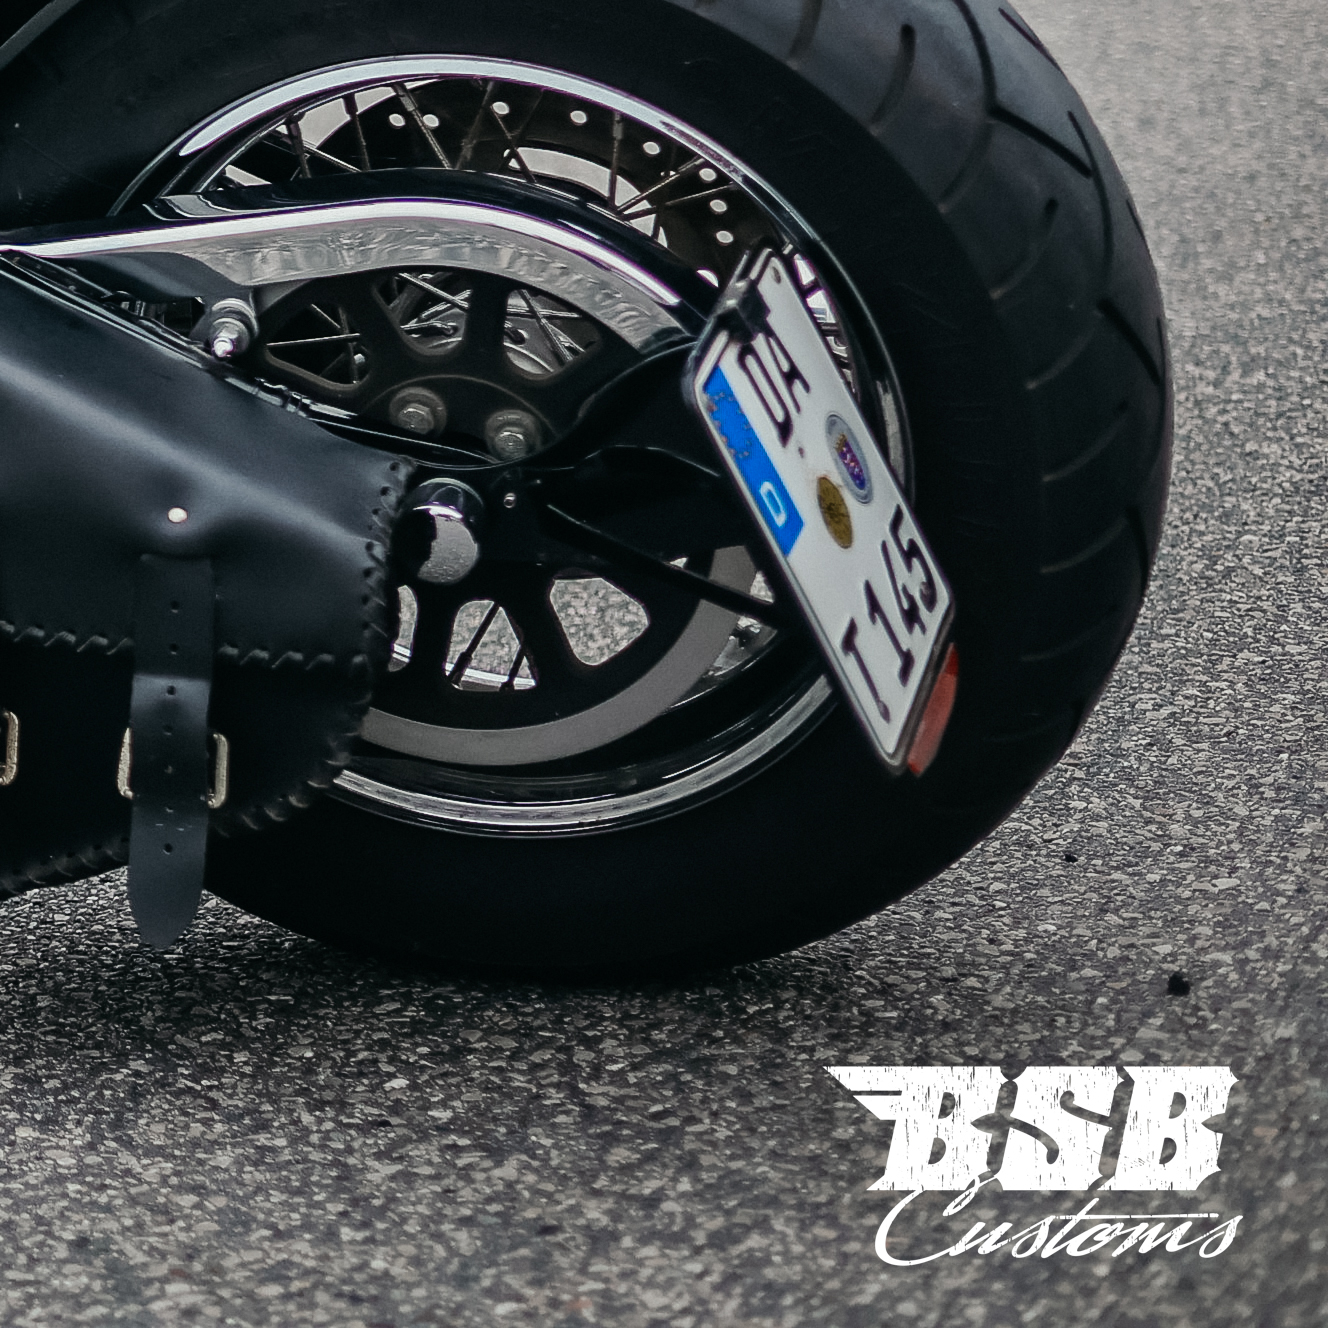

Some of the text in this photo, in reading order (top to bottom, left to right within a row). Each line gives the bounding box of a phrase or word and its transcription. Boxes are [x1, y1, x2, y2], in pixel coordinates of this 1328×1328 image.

[759, 480, 788, 529] D
[840, 503, 938, 724] T 145
